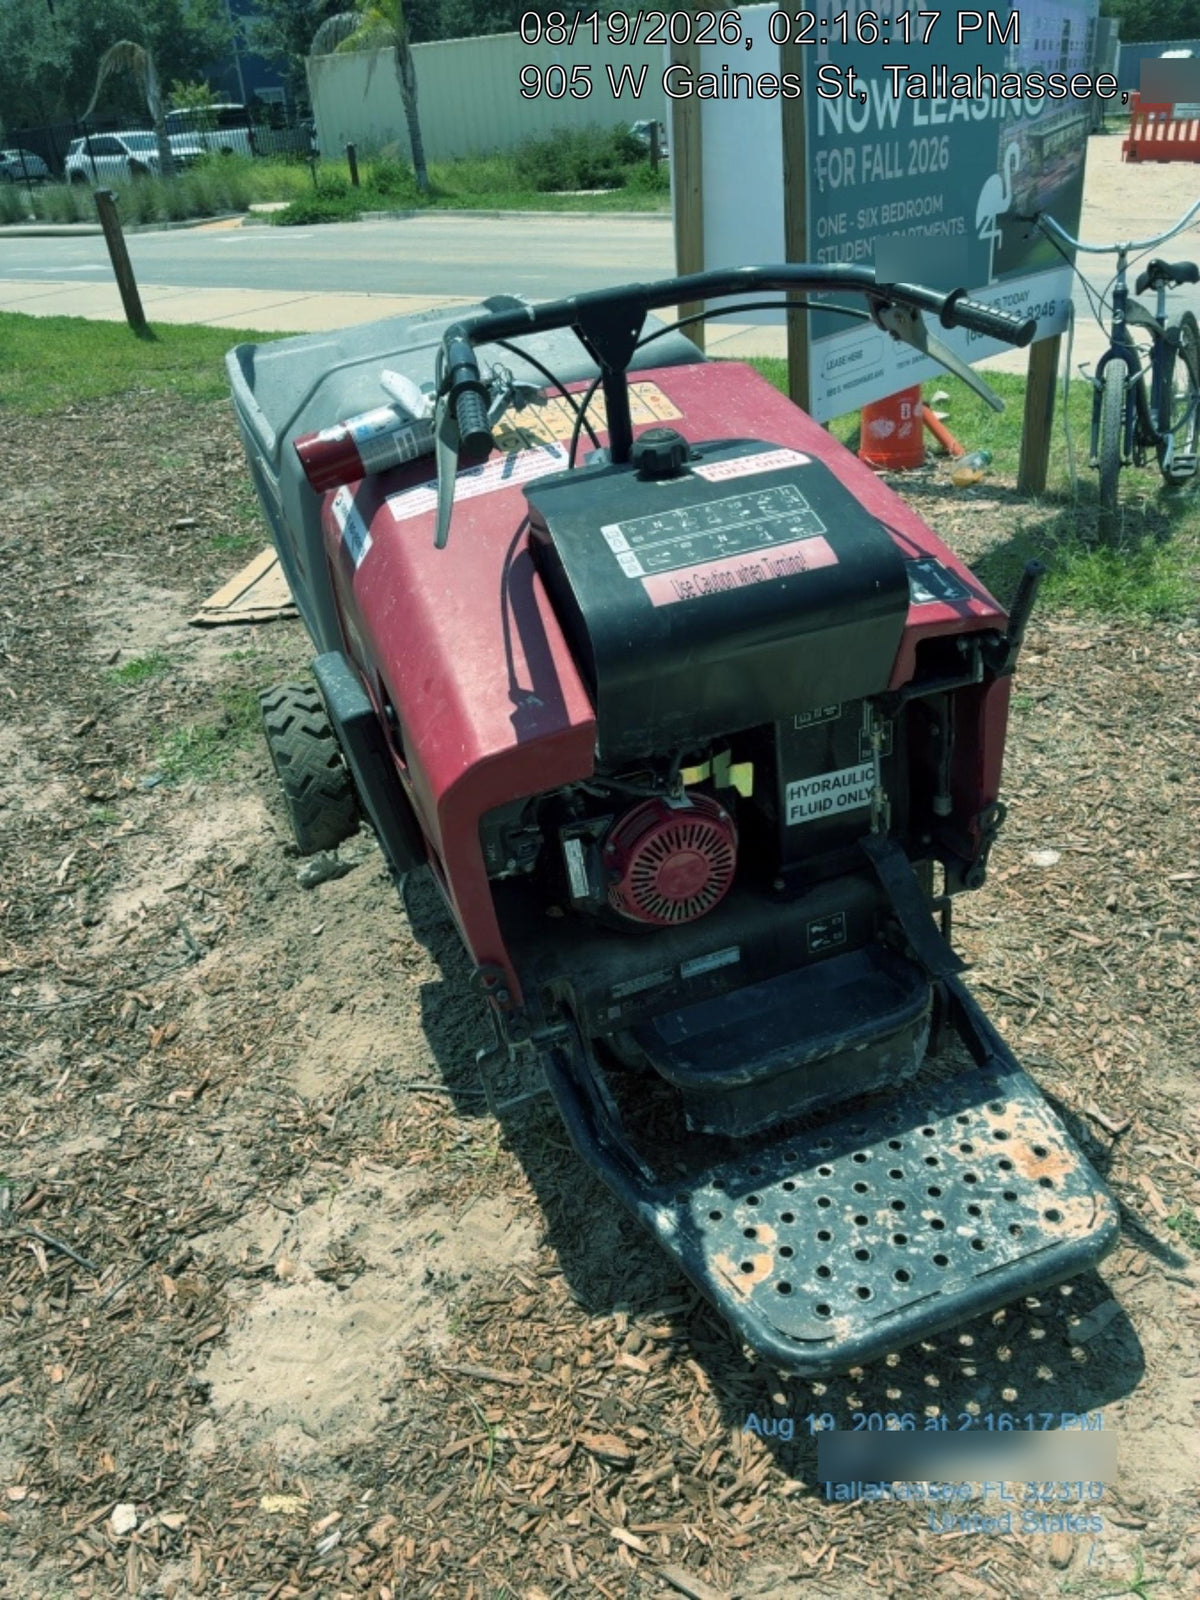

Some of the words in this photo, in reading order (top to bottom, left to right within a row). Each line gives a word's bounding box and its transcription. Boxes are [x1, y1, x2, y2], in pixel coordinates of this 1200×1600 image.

[817, 76, 906, 136] NOW
[816, 147, 856, 192] FOR
[861, 142, 904, 184] FALL
[908, 135, 949, 176] 2026
[816, 213, 847, 239] ONE
[857, 206, 879, 230] SIX
[881, 194, 943, 225] BEDROOM
[817, 235, 876, 265] STUDEN
[670, 579, 695, 601] Use
[693, 568, 738, 596] Caution
[791, 767, 875, 800] HYDRAULIC
[791, 797, 833, 819] FLUID
[837, 785, 875, 806] ONLY
